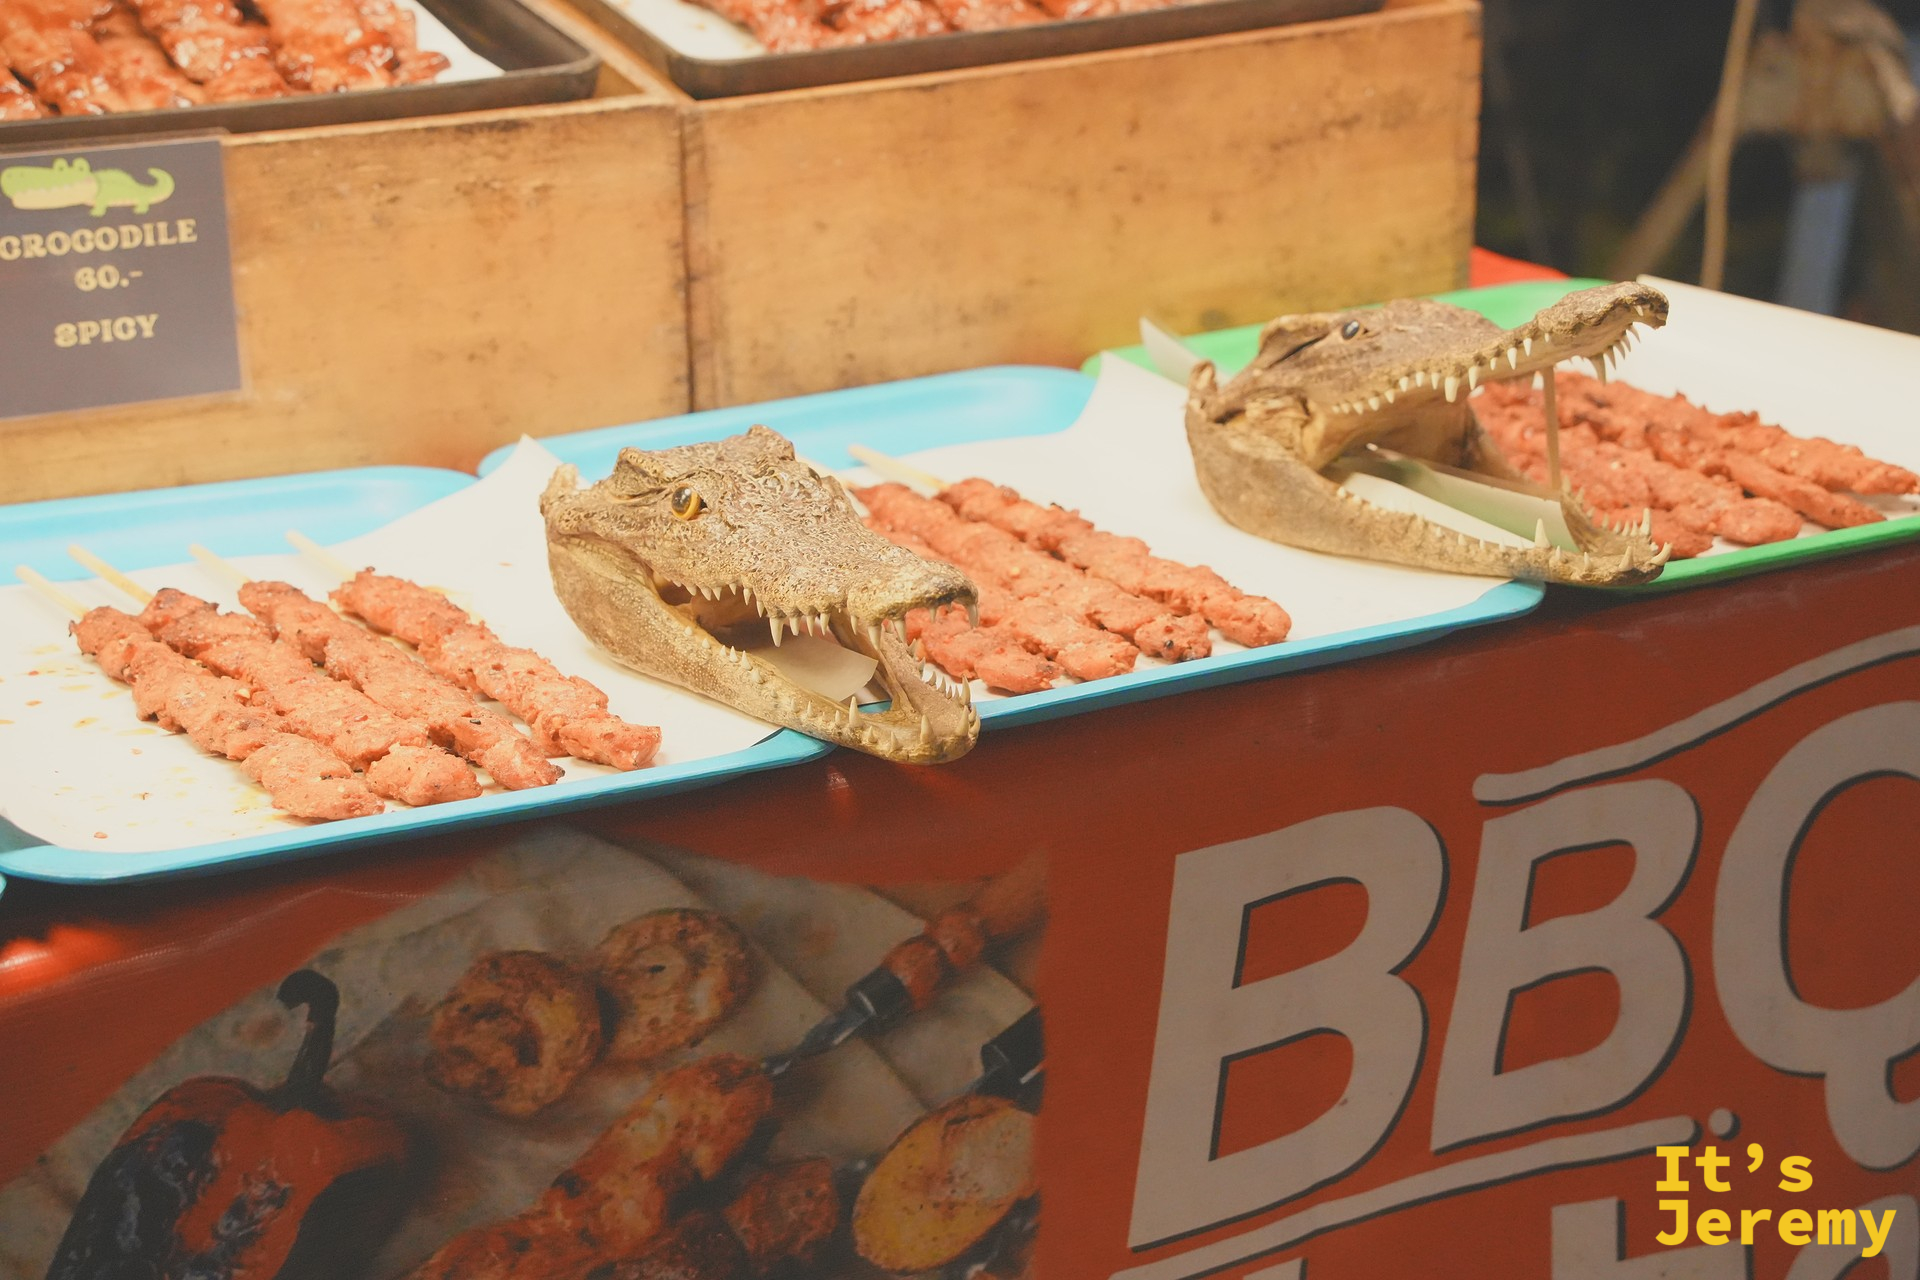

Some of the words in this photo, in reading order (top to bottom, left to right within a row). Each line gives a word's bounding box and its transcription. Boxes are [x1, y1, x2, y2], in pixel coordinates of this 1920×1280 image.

[0, 218, 198, 260] CROCODILE
[54, 313, 159, 347] SPICY
[1128, 699, 1920, 1252] BBQ
